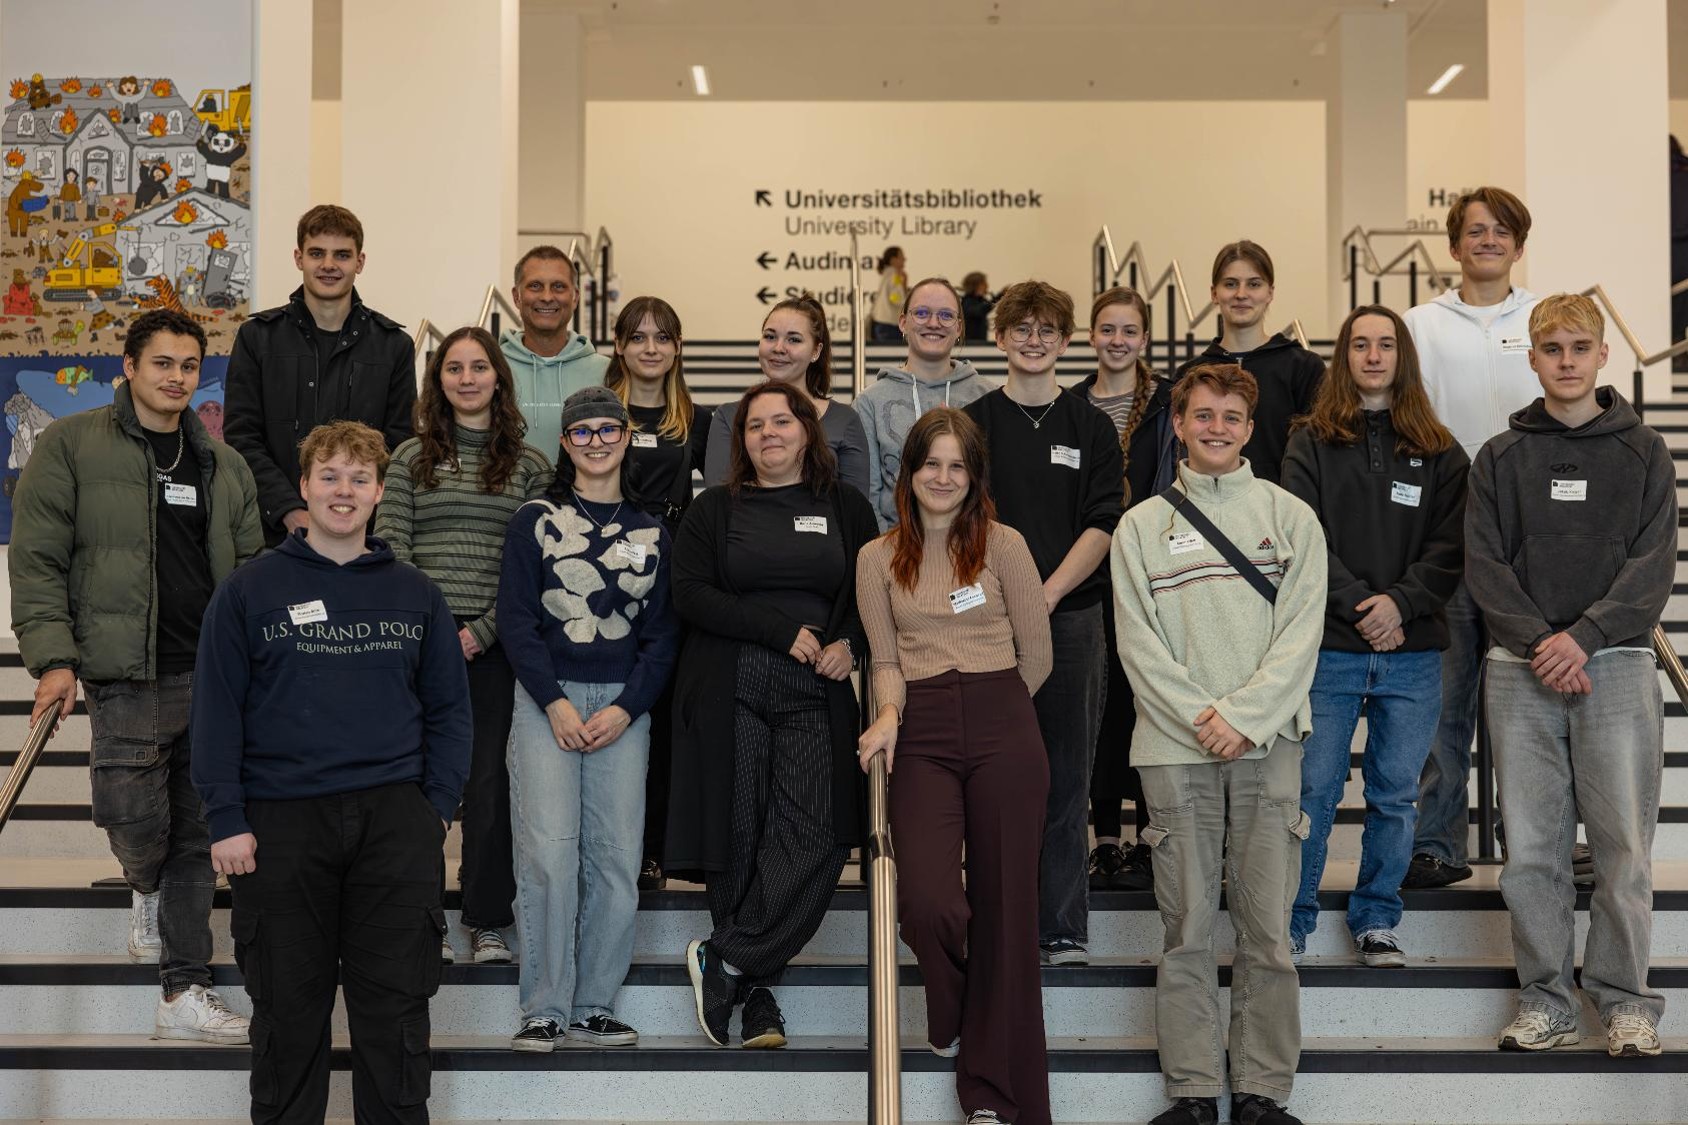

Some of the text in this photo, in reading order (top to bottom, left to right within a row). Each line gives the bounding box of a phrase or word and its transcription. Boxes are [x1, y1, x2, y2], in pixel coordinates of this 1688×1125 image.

[785, 189, 1042, 208] Universitätsbibliothek
[785, 216, 977, 239] University Library
[263, 621, 424, 641] U.S. GRAND POLO
[296, 641, 403, 655] EQUIPMENT & APPAREL
